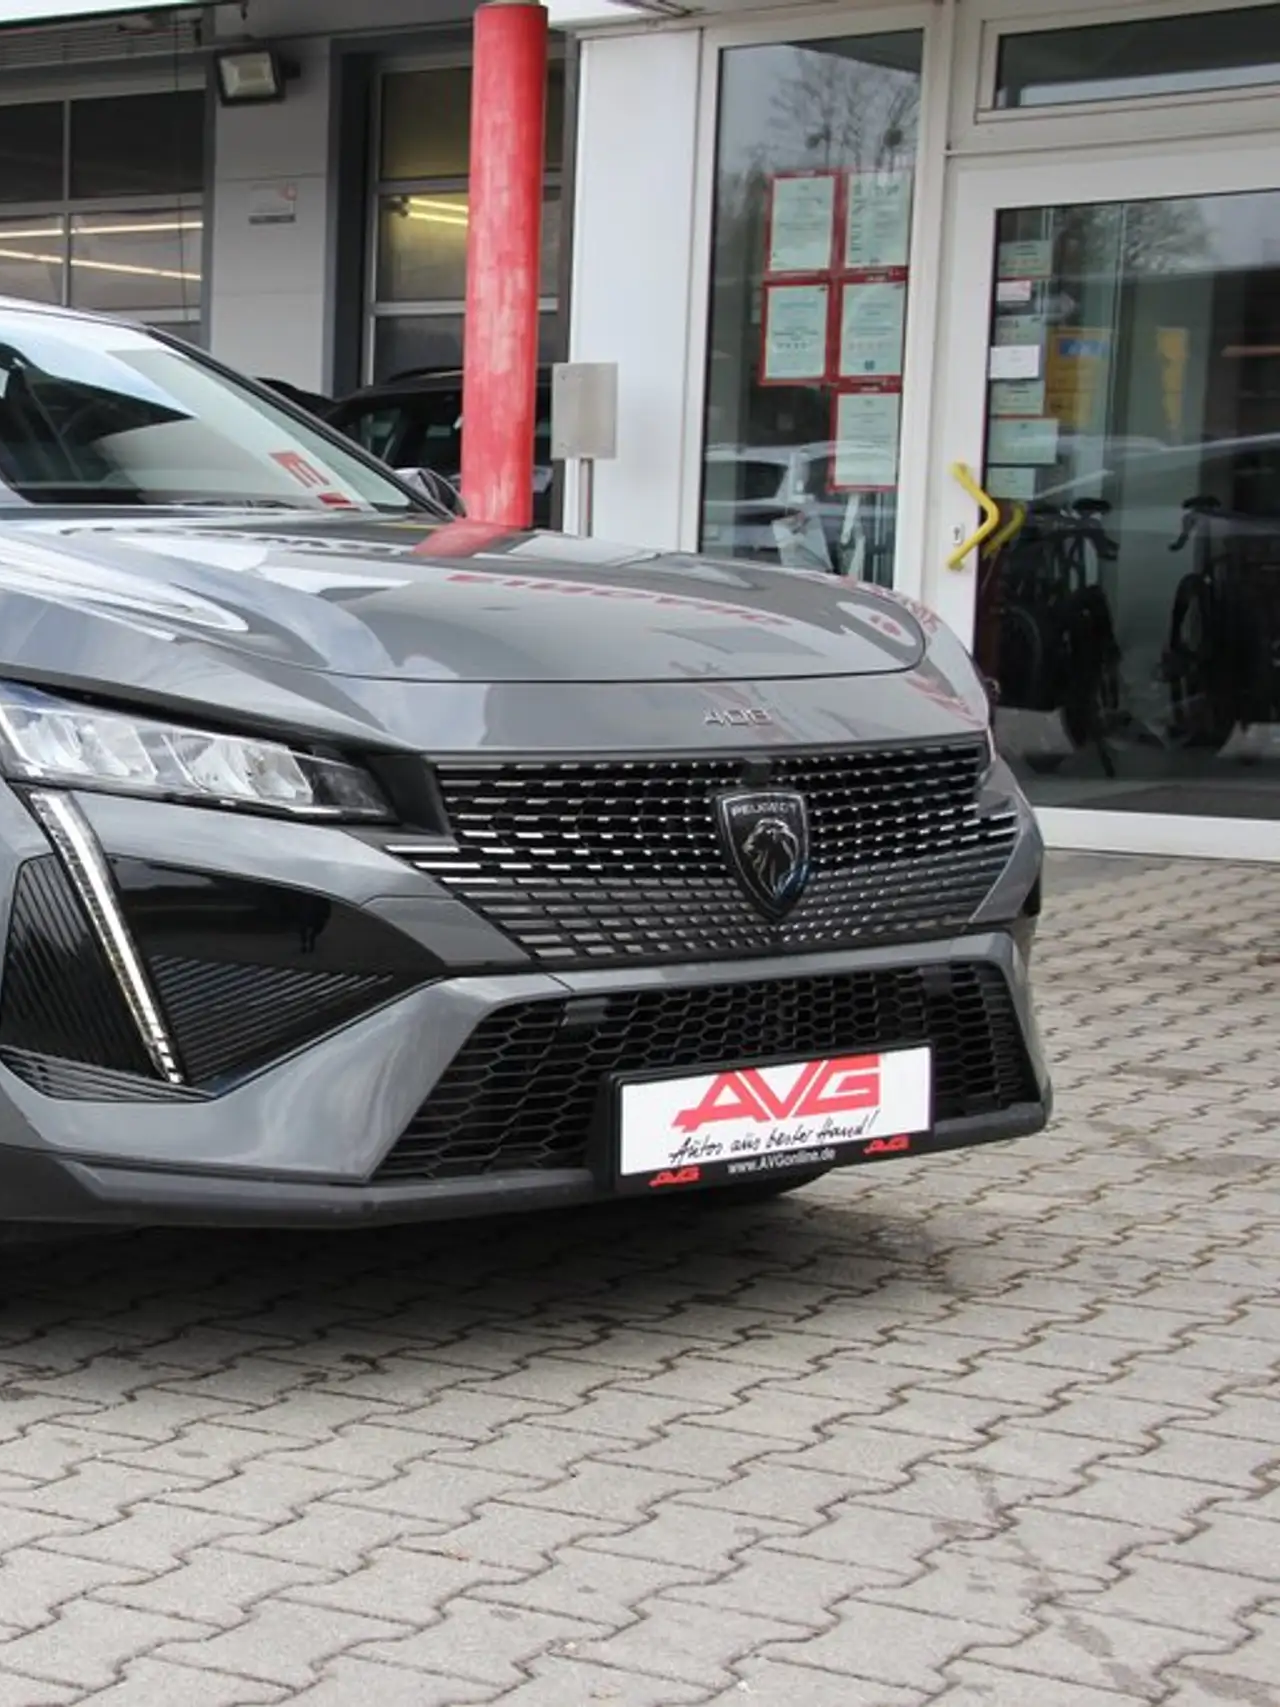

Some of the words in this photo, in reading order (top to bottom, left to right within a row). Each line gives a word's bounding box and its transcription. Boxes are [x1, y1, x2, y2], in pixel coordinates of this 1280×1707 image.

[730, 801, 796, 816] PEUGEOT
[671, 1053, 880, 1133] AVG
[727, 1147, 836, 1174] www.AVGonline.de
